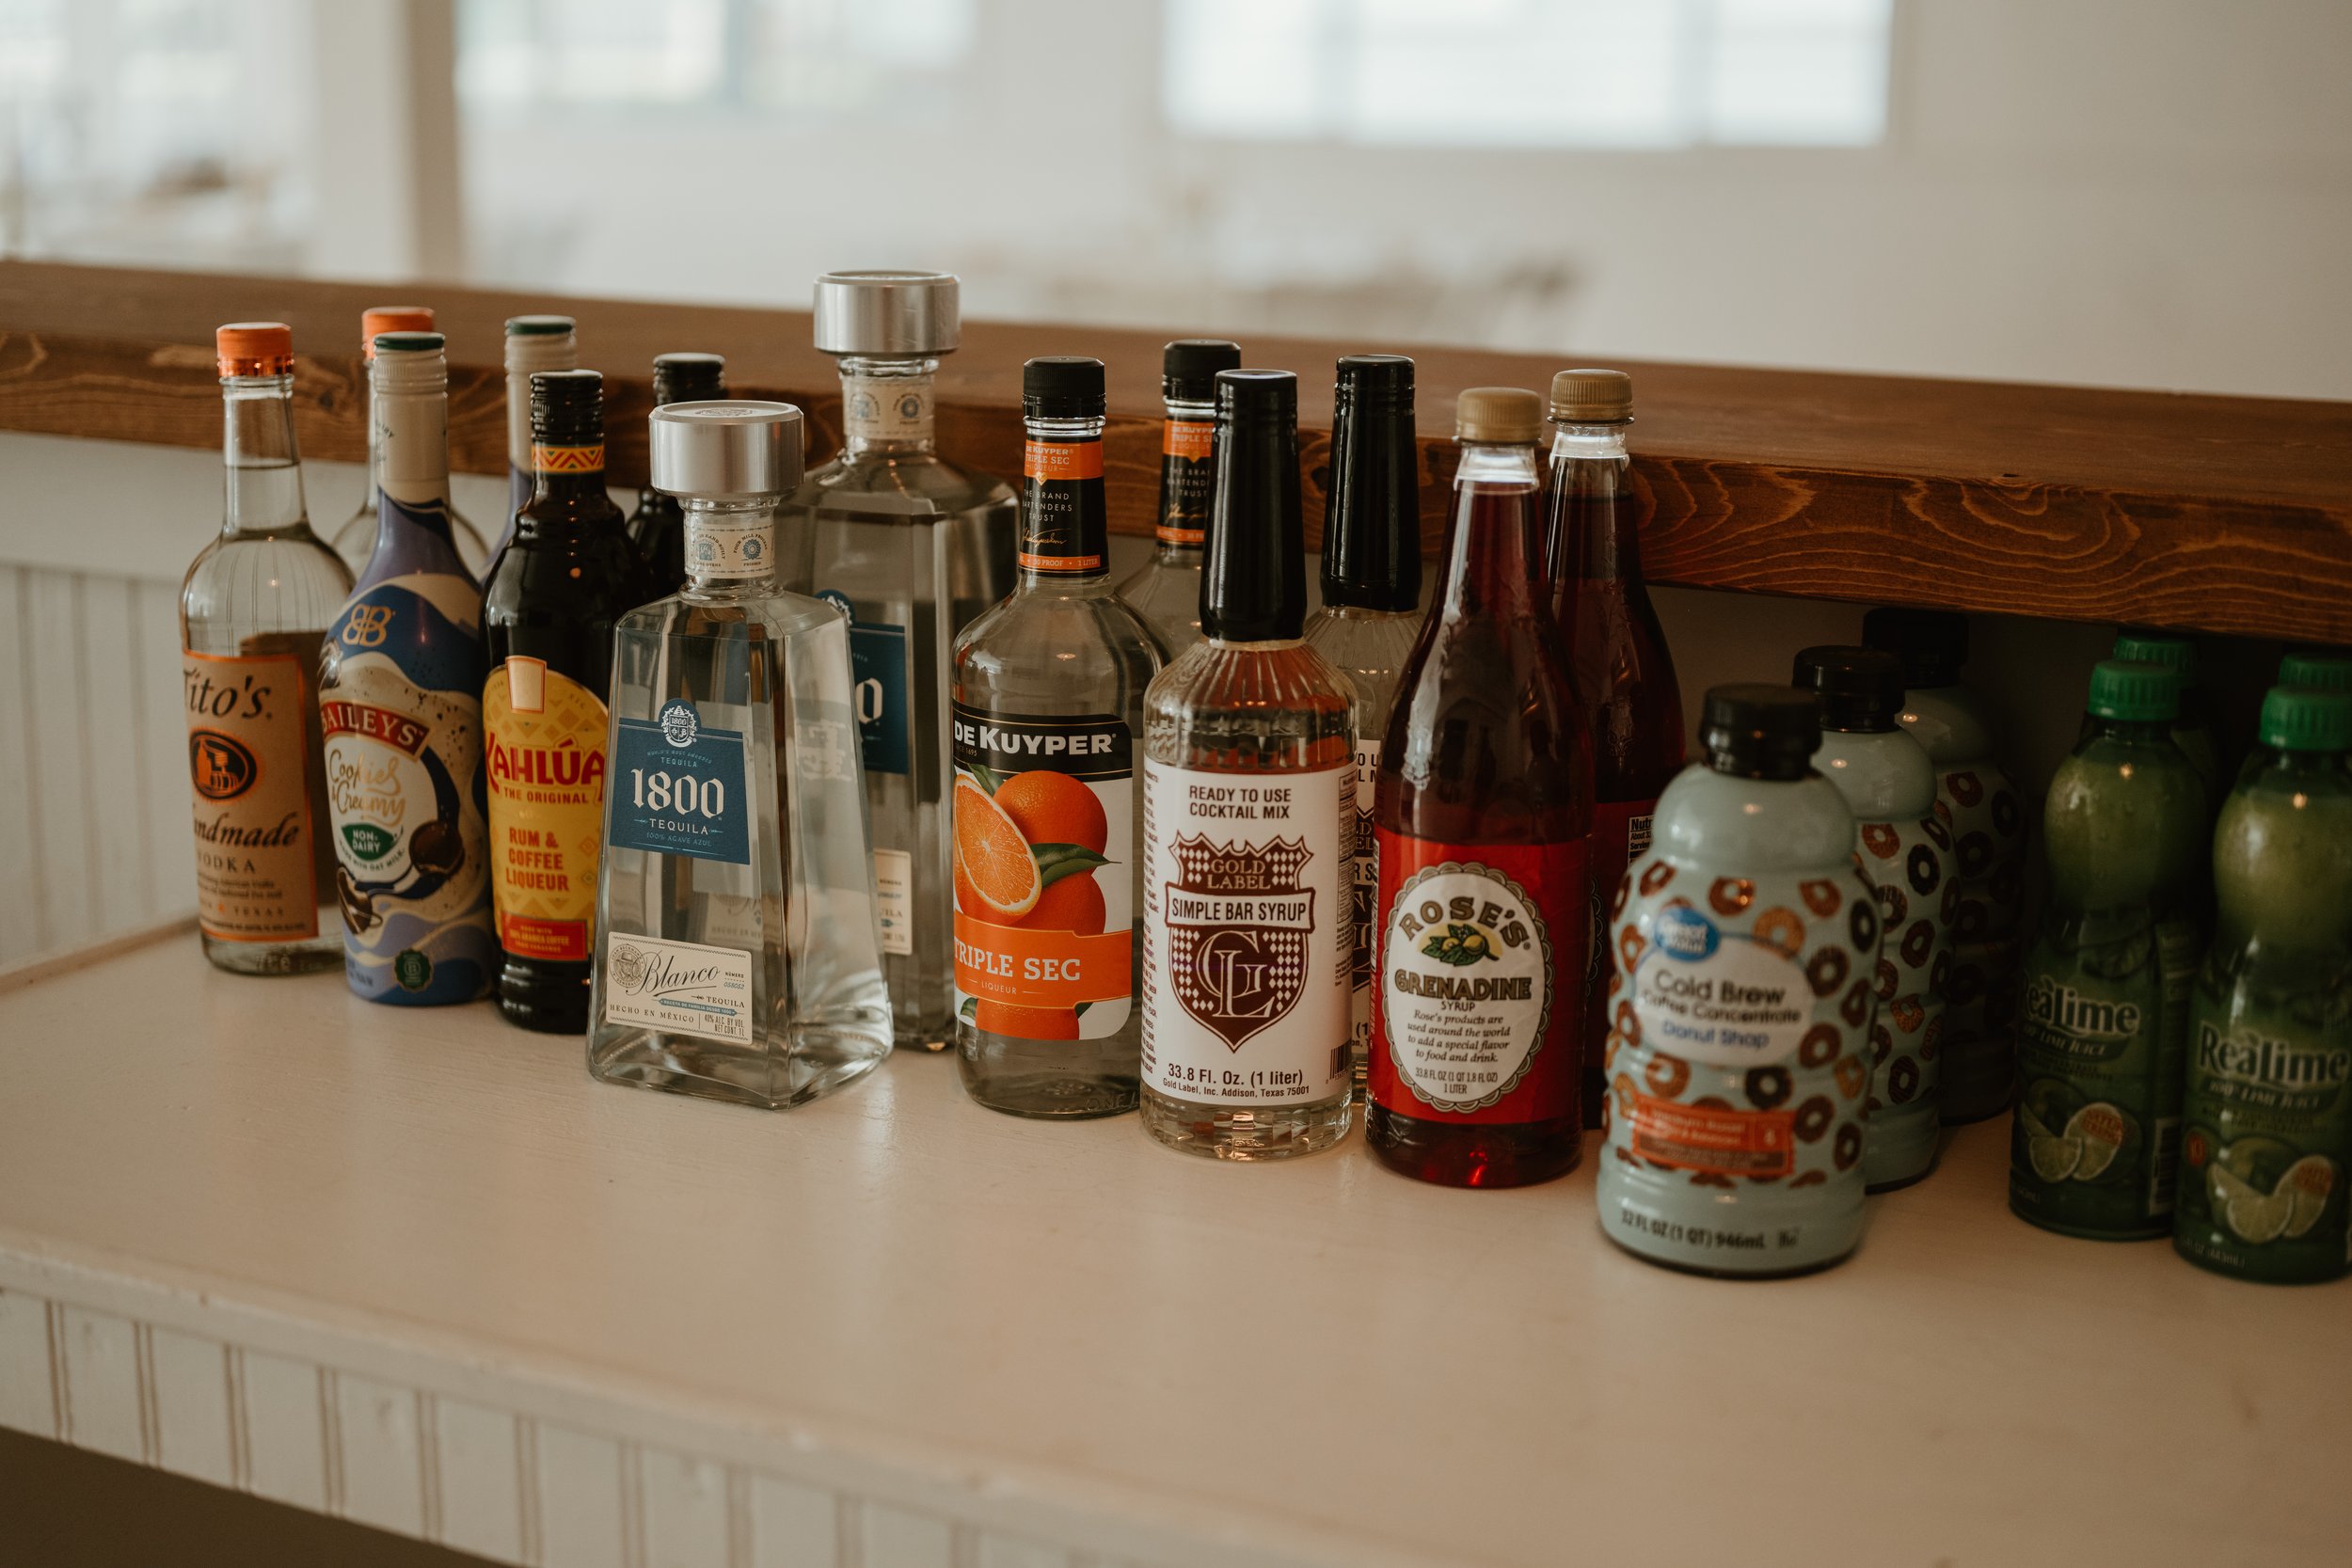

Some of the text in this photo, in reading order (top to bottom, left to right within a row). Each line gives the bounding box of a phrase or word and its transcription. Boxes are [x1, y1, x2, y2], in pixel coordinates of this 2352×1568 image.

[1051, 456, 1070, 465] SEC
[1037, 490, 1070, 500] BRAND
[1029, 513, 1054, 522] TRUST
[671, 717, 687, 726] 1800
[660, 756, 697, 768] TEQUILA
[504, 786, 588, 805] THE ORIGINAL
[630, 768, 724, 819] 1800
[1189, 785, 1292, 802] READY TO USE
[1190, 802, 1290, 819] COCKTAIL MIX
[649, 817, 708, 835] TEQUILA
[353, 840, 380, 852] DAIRY
[509, 828, 559, 849] RUM &
[646, 832, 712, 847] 100% AGAVE AZUL
[508, 848, 564, 870] COFFEE
[1211, 859, 1266, 875] GOLD
[506, 867, 569, 892] LIQUEUR
[1206, 874, 1271, 890] LABEL
[1172, 897, 1307, 921] SIMPLE BAR SYRUP
[1399, 895, 1530, 948] ROSE'S
[954, 936, 1081, 981] TRIPLE SEC
[626, 950, 719, 996] Blanco
[981, 980, 1017, 994] LIQUEUR
[1394, 969, 1533, 1002] GRENADINE
[1656, 969, 1786, 1004] Cold Brew
[706, 996, 745, 1008] TEQUILA
[1441, 1001, 1476, 1012] SYRUP
[1643, 989, 1803, 1024] Coffee Concentrate
[610, 1004, 694, 1023] HECHO EN MÉXICO
[704, 1014, 714, 1023] 40%
[727, 1018, 734, 1026] BY
[1414, 1009, 1503, 1025] Rose's products are
[714, 1023, 723, 1033] NET
[1407, 1022, 1511, 1037] used around the world
[1661, 1021, 1769, 1049] Donut Shop
[1407, 1035, 1416, 1043] to
[1418, 1037, 1435, 1046] add
[1445, 1039, 1479, 1052] special
[1479, 1040, 1510, 1053] flavor
[1416, 1049, 1498, 1063] to food and drink.
[1168, 1063, 1303, 1088] 33.8 Fl. Oz. (1 liter)
[1415, 1067, 1498, 1083] 33.8 FL OZ (1 QT 1.8 FL OZ)
[1163, 1077, 1310, 1098] Gold Label, Inc. Addison, Texas 75001
[1449, 1084, 1468, 1094] LITER
[1636, 1214, 1648, 1232] FL
[1651, 1219, 1668, 1238] OZ
[1670, 1223, 1683, 1241] (1
[1686, 1227, 1712, 1246] QT)
